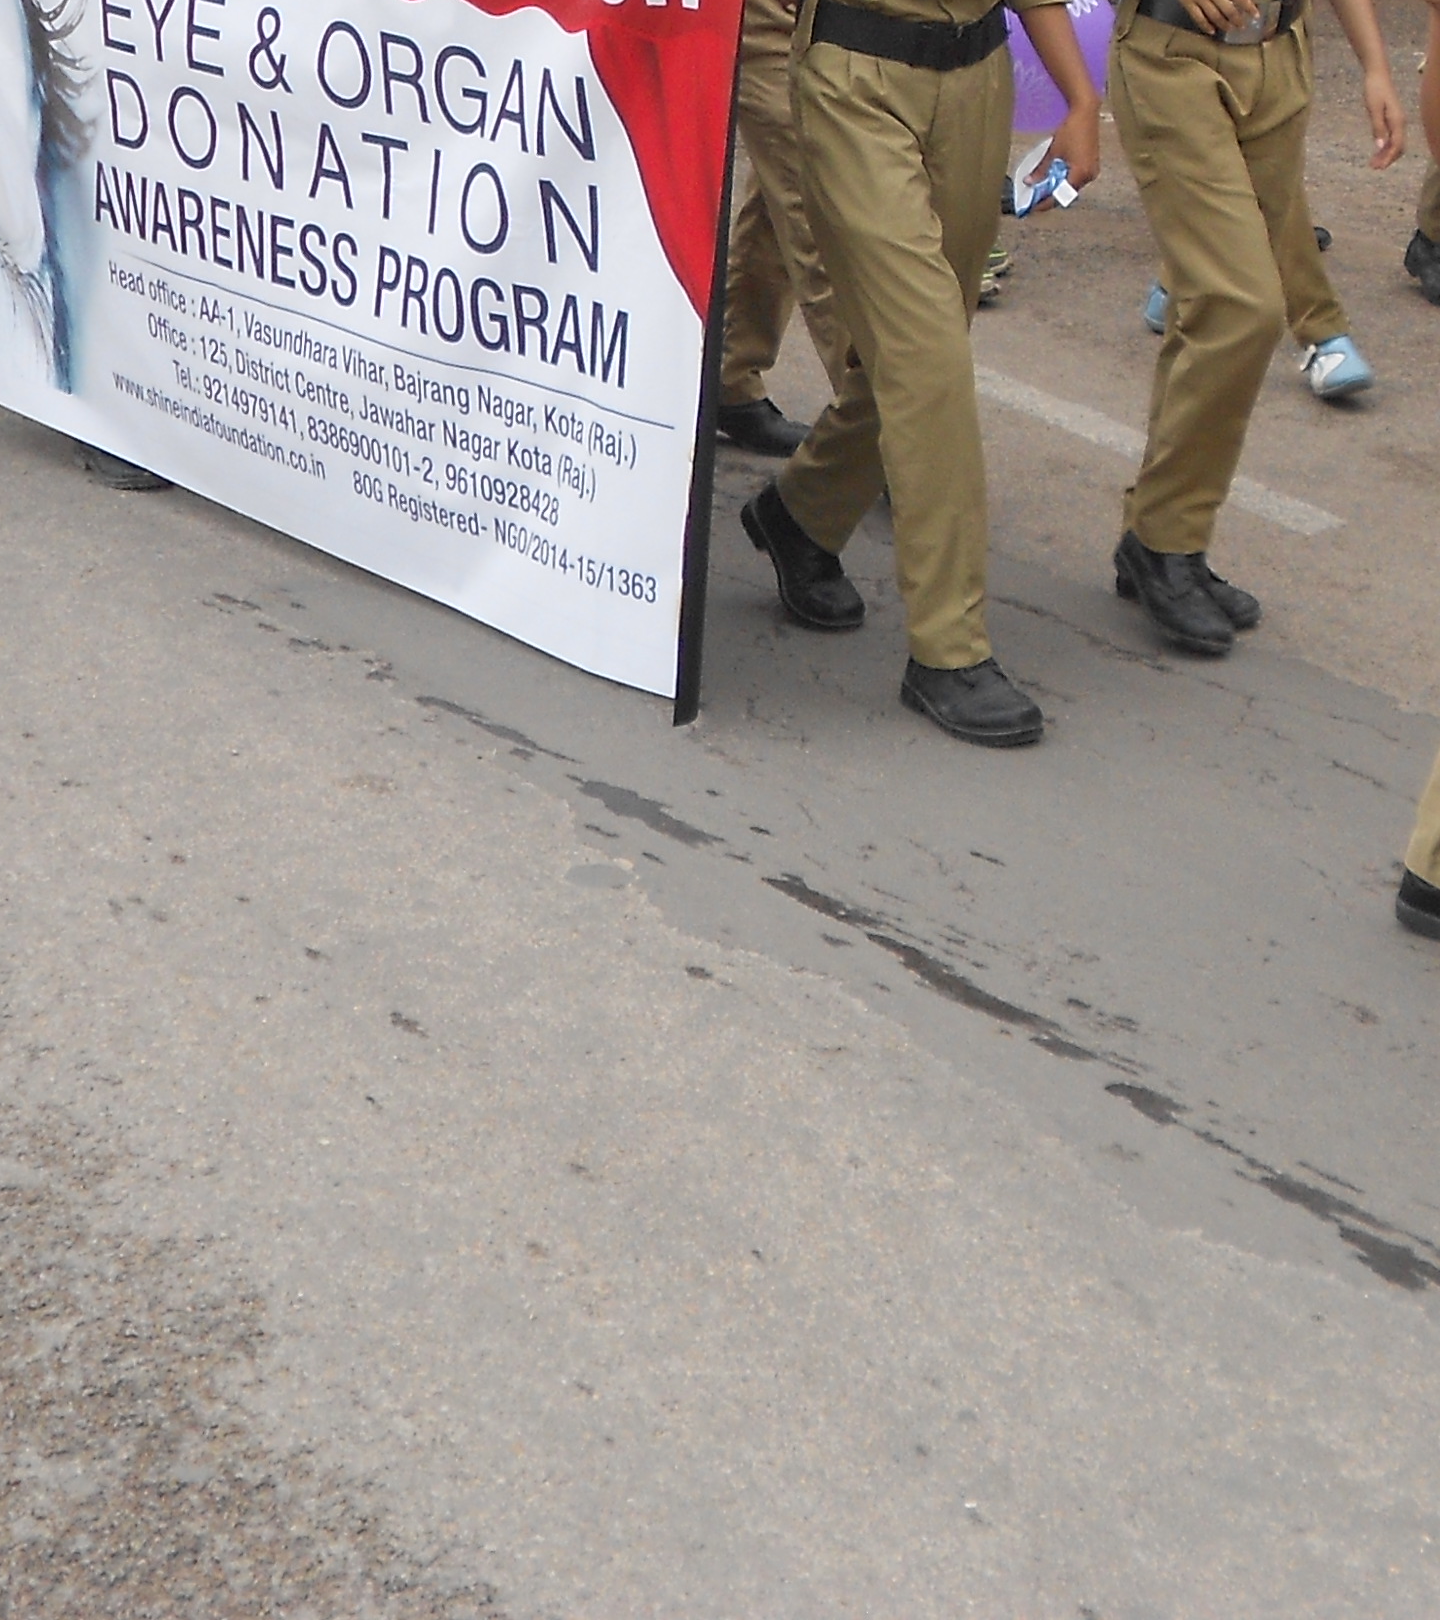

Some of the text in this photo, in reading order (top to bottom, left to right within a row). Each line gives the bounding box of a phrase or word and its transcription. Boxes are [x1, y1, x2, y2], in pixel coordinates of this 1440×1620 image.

[106, 67, 600, 273] DONATION
[247, 5, 294, 95] &
[316, 19, 597, 162] ORGAN
[94, 159, 630, 389] AWARENESS PROGRAM
[109, 260, 145, 302] Head
[148, 278, 187, 315] office
[199, 296, 241, 338] AA-1,
[243, 310, 338, 371] Vasundhara
[342, 345, 389, 392] Vihar,
[393, 363, 470, 415] Bajrang
[477, 384, 538, 434] Nagar,
[543, 404, 584, 445] Kota
[588, 421, 638, 471] (Raj.)
[112, 370, 658, 604] www.shineindiafoundation.co.in 80G Registered- NGO/2014-15/1363
[147, 311, 187, 353] Office
[200, 336, 233, 374] 125,
[236, 348, 291, 394] District
[295, 370, 355, 420] Centre,
[359, 394, 436, 444] Jawahar
[442, 420, 502, 463] Nagar
[507, 438, 553, 477] Kota
[557, 454, 597, 504] (Raj.)
[203, 374, 305, 442] 9214979141,
[308, 414, 440, 491] 8386900101-2,
[444, 463, 560, 527] 9610928428
